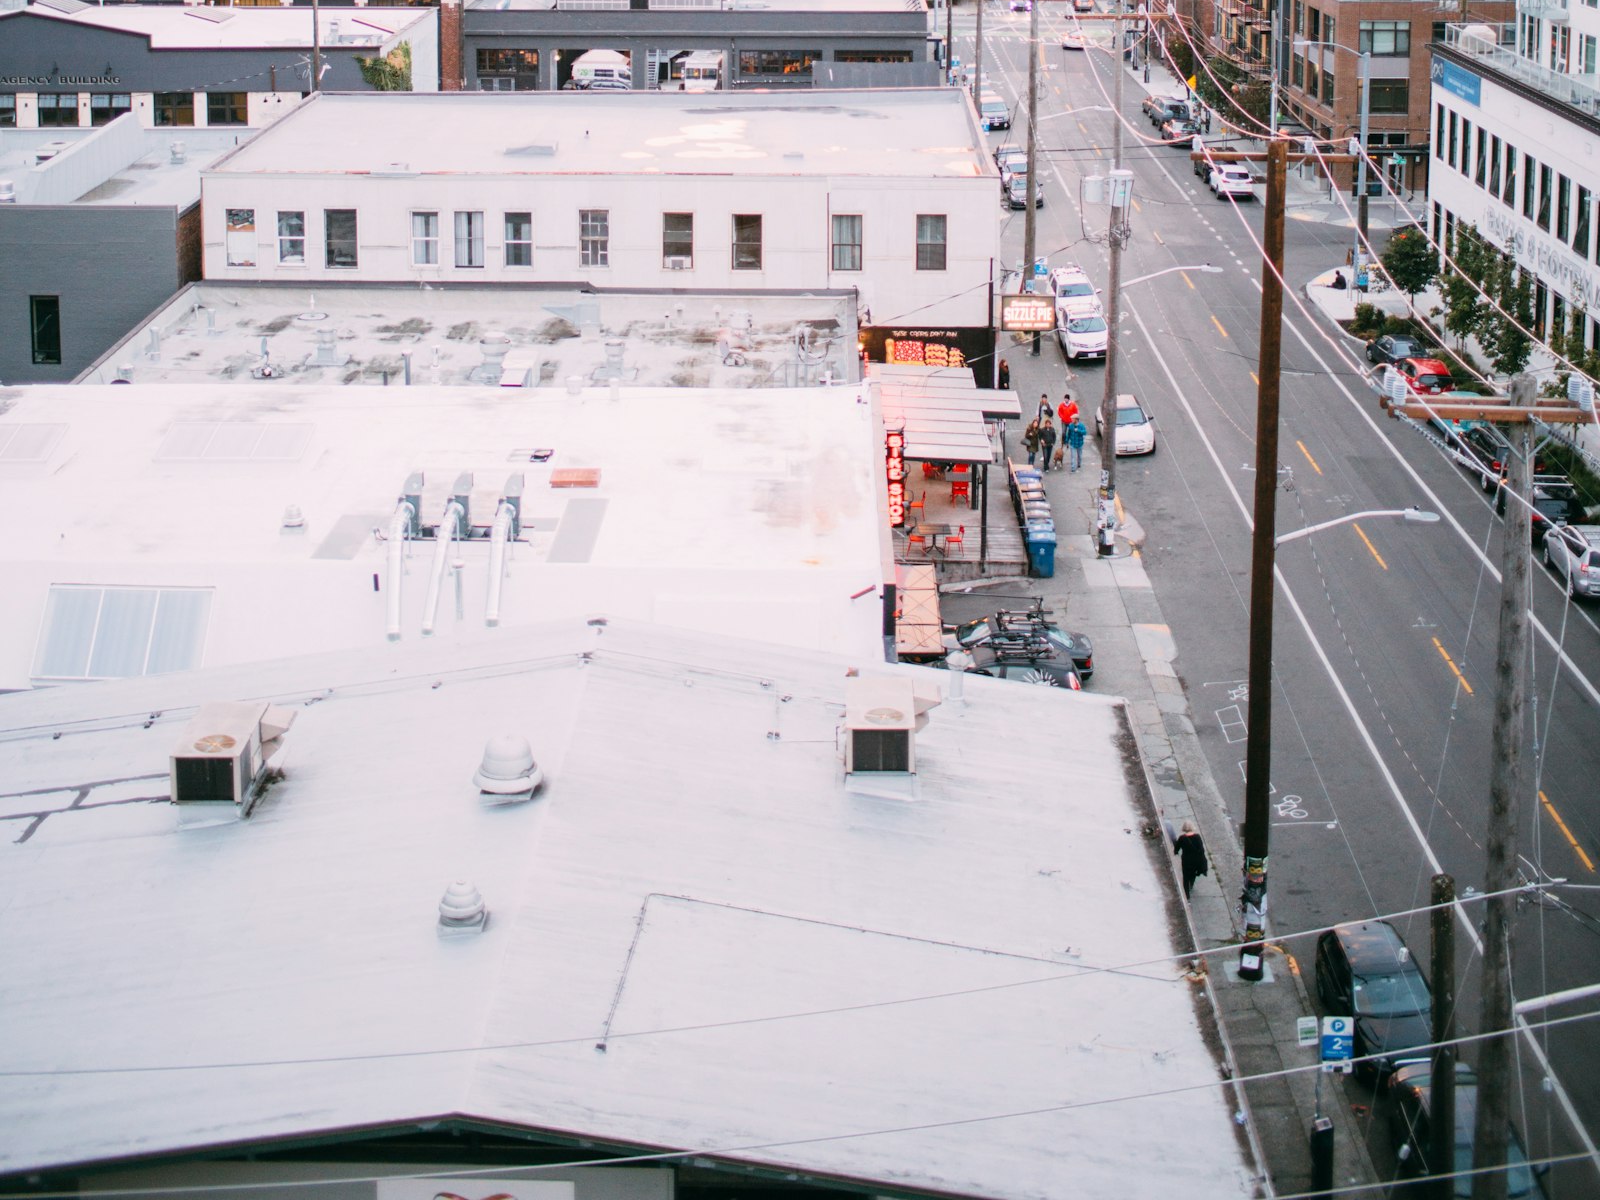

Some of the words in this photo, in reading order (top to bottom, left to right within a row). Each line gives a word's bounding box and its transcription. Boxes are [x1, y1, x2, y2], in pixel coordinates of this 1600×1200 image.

[0, 76, 53, 86] AGENCY
[58, 76, 121, 86] BUILDING
[1004, 307, 1036, 321] SIZZLE
[1037, 307, 1053, 321] PIE
[887, 435, 904, 481] BIKE
[888, 482, 904, 525] SHOP
[1332, 1037, 1343, 1050] 2
